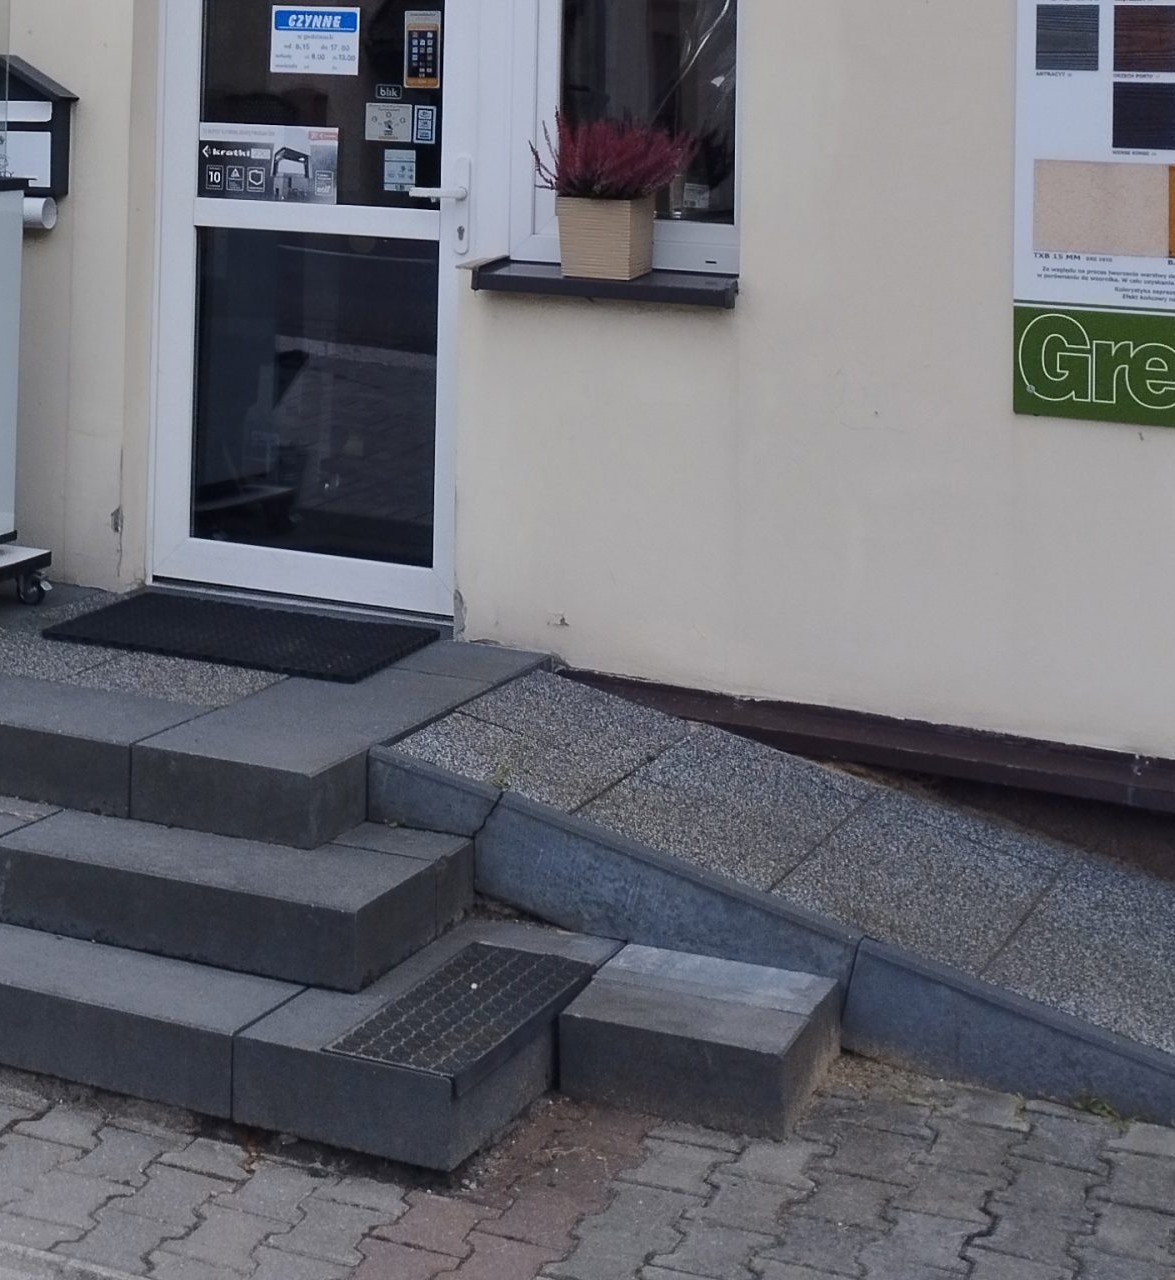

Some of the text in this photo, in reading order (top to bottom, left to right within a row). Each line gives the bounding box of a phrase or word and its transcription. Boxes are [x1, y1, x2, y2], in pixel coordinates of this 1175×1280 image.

[288, 14, 342, 28] CZYNNE
[379, 88, 398, 97] blik
[213, 148, 250, 157] kratki
[208, 171, 221, 183] 10
